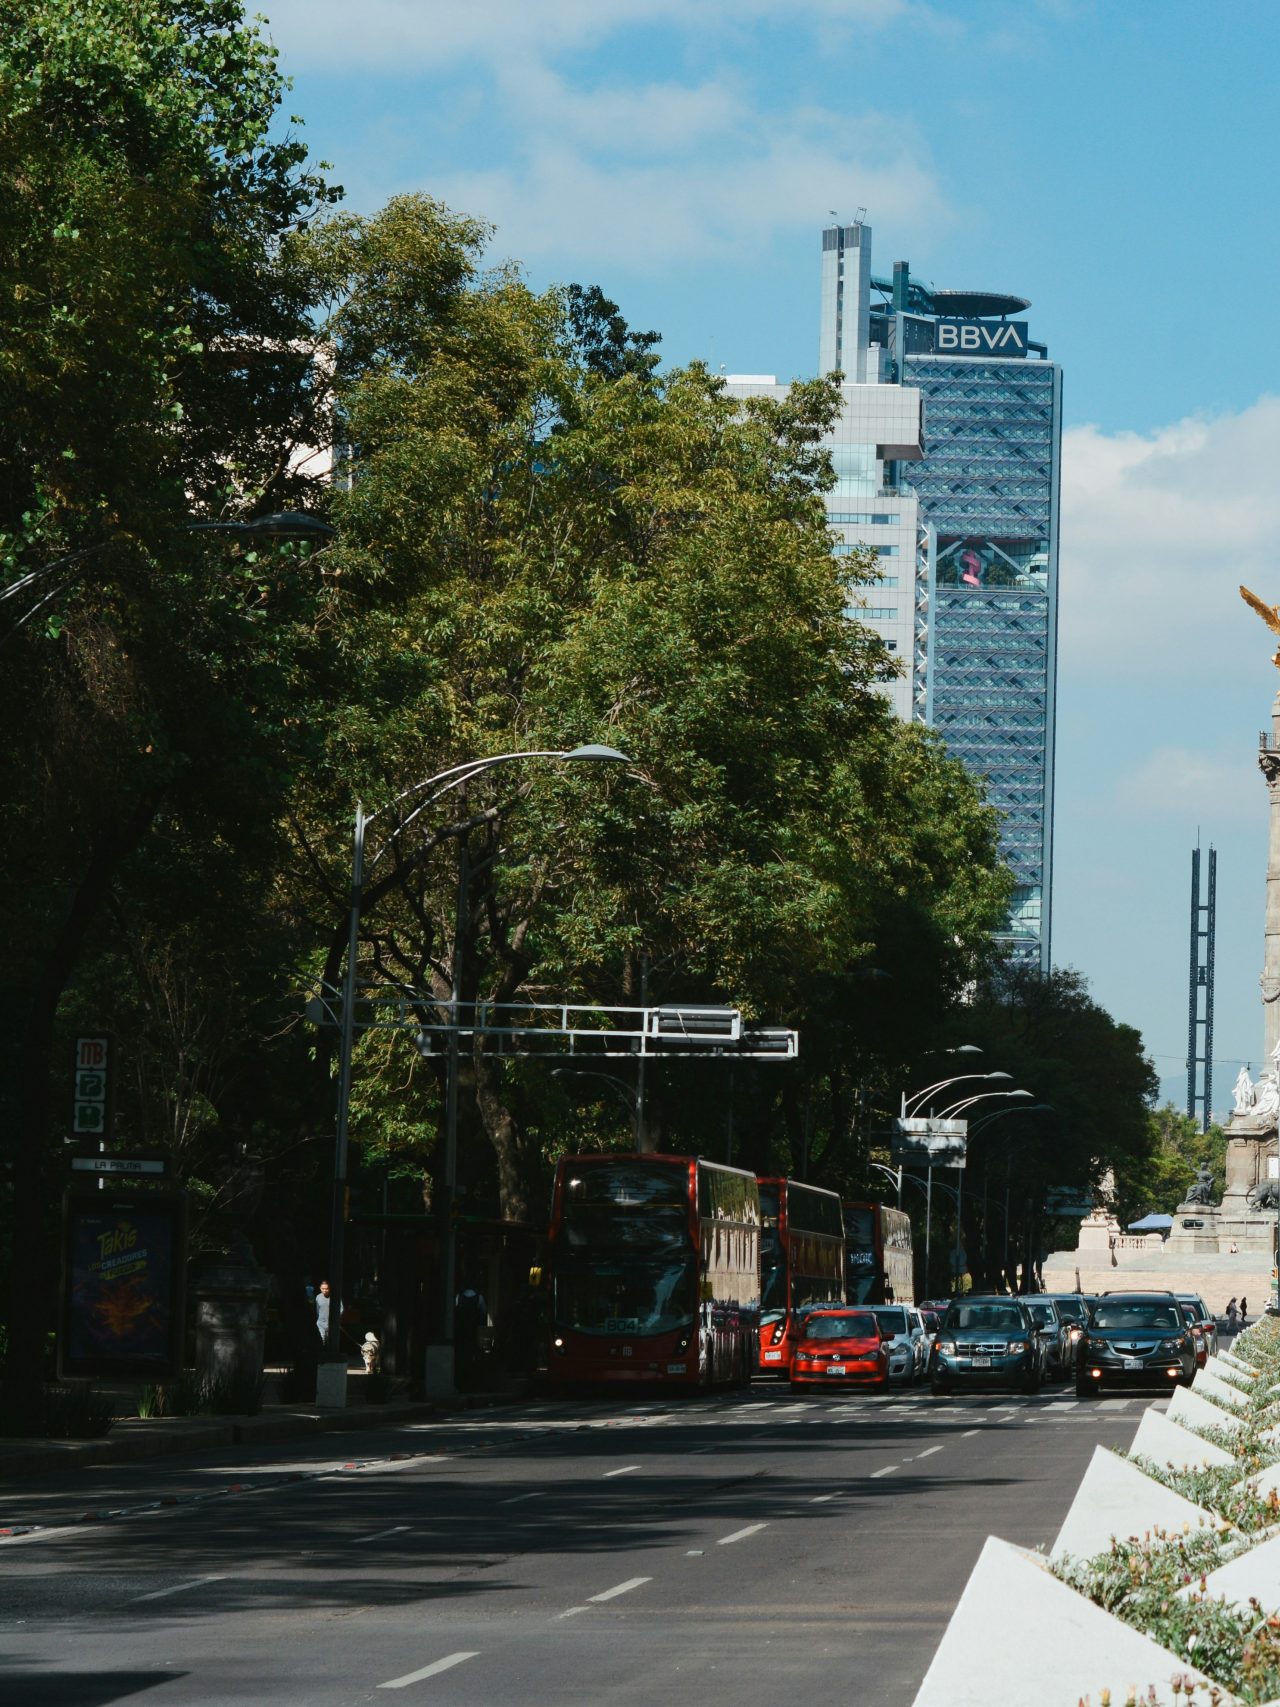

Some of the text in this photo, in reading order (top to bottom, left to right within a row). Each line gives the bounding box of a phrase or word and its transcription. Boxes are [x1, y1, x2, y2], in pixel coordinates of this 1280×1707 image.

[938, 323, 1024, 350] BBVA
[94, 1161, 142, 1170] LA PALMA
[96, 1227, 138, 1262] Takis
